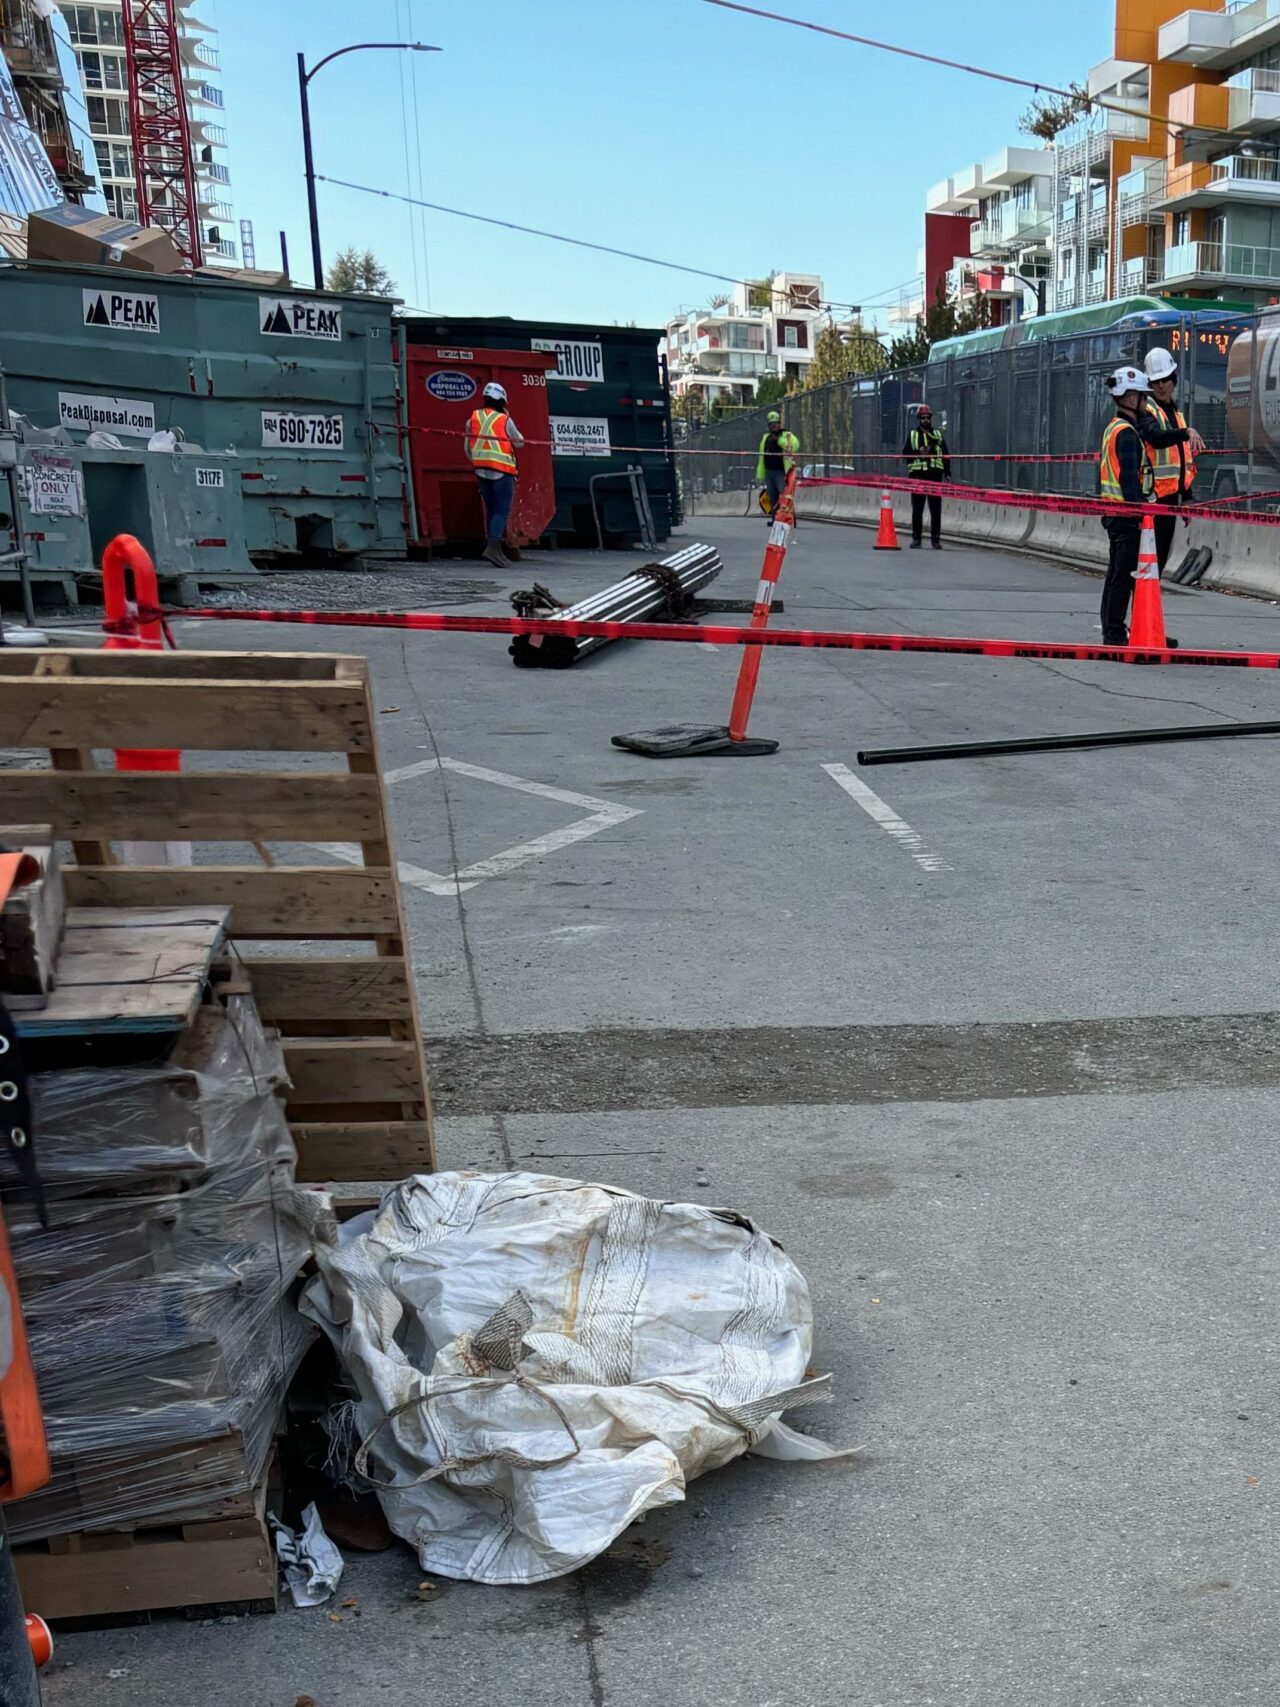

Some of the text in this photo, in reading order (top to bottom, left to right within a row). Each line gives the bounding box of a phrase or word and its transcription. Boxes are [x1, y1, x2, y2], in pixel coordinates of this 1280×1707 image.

[111, 295, 158, 325] PEAK
[293, 305, 339, 333] PEAK
[555, 343, 601, 378] GROUP
[522, 374, 546, 387] 3030
[61, 402, 153, 428] PeakDisposal.com
[34, 470, 76, 483] CONCRETE
[41, 481, 69, 495] ONLY
